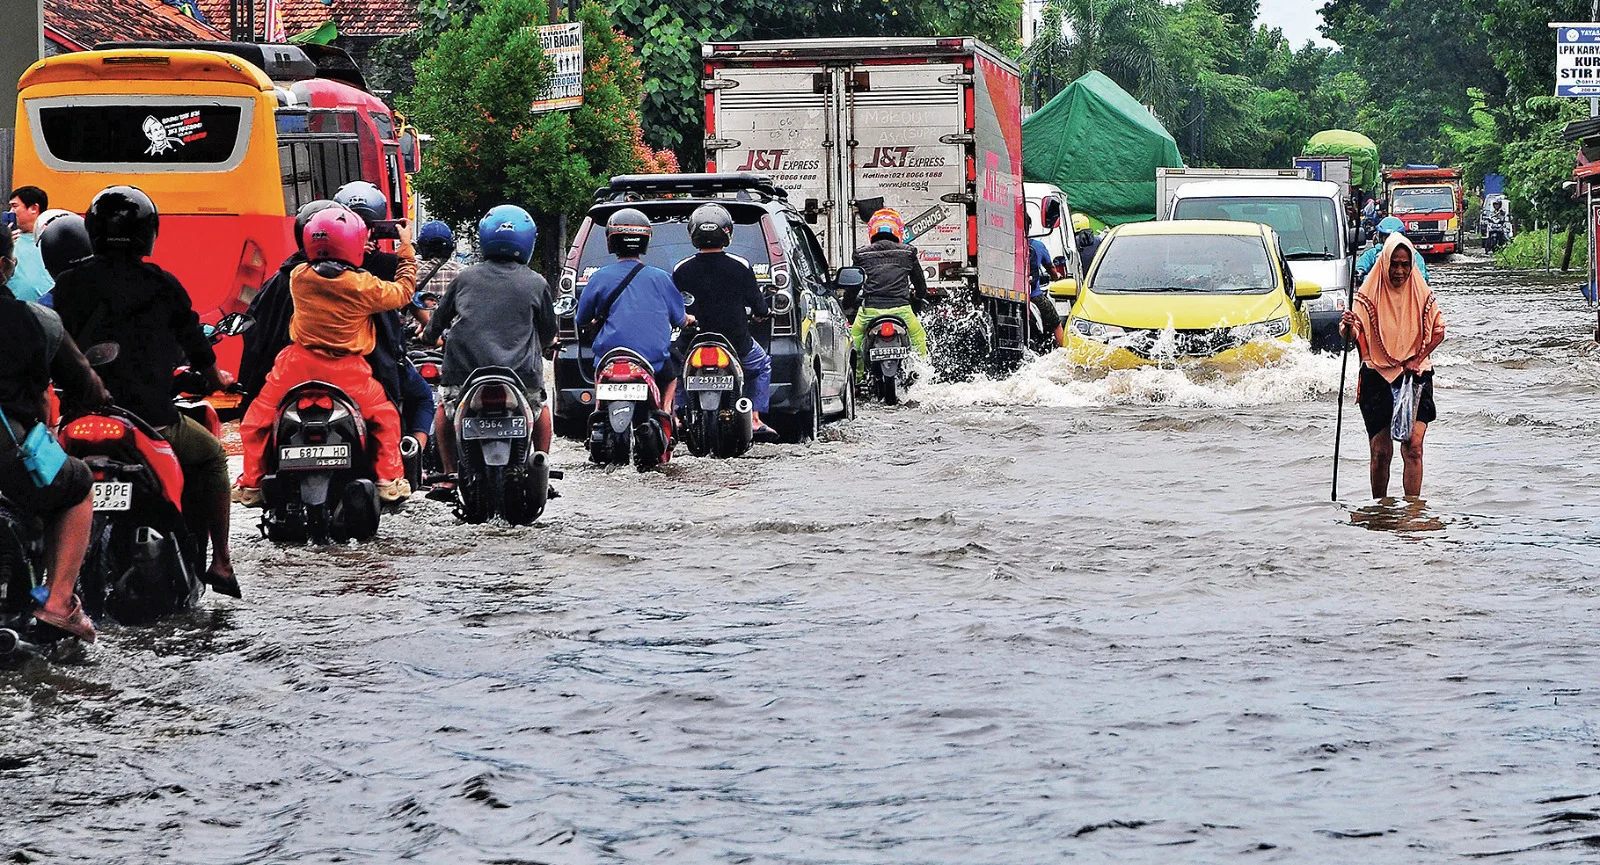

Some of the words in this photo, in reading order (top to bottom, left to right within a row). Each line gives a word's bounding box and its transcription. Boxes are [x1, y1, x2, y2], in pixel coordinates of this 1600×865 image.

[554, 34, 580, 48] BADAN
[1559, 46, 1575, 55] LPK
[1577, 46, 1600, 55] KARY
[1575, 57, 1600, 67] KUR
[1561, 69, 1592, 78] STIR
[736, 149, 790, 171] J&T
[783, 160, 819, 170] EXPRESS
[862, 147, 915, 168] J&T
[909, 157, 945, 168] EXPRESS
[911, 210, 942, 234] GODHOG
[699, 376, 717, 384] 2571
[465, 420, 471, 428] K
[479, 420, 502, 428] 3564
[512, 419, 524, 427] FZ
[284, 449, 290, 459] K
[300, 448, 324, 458] 6877
[106, 485, 128, 496] BPE
